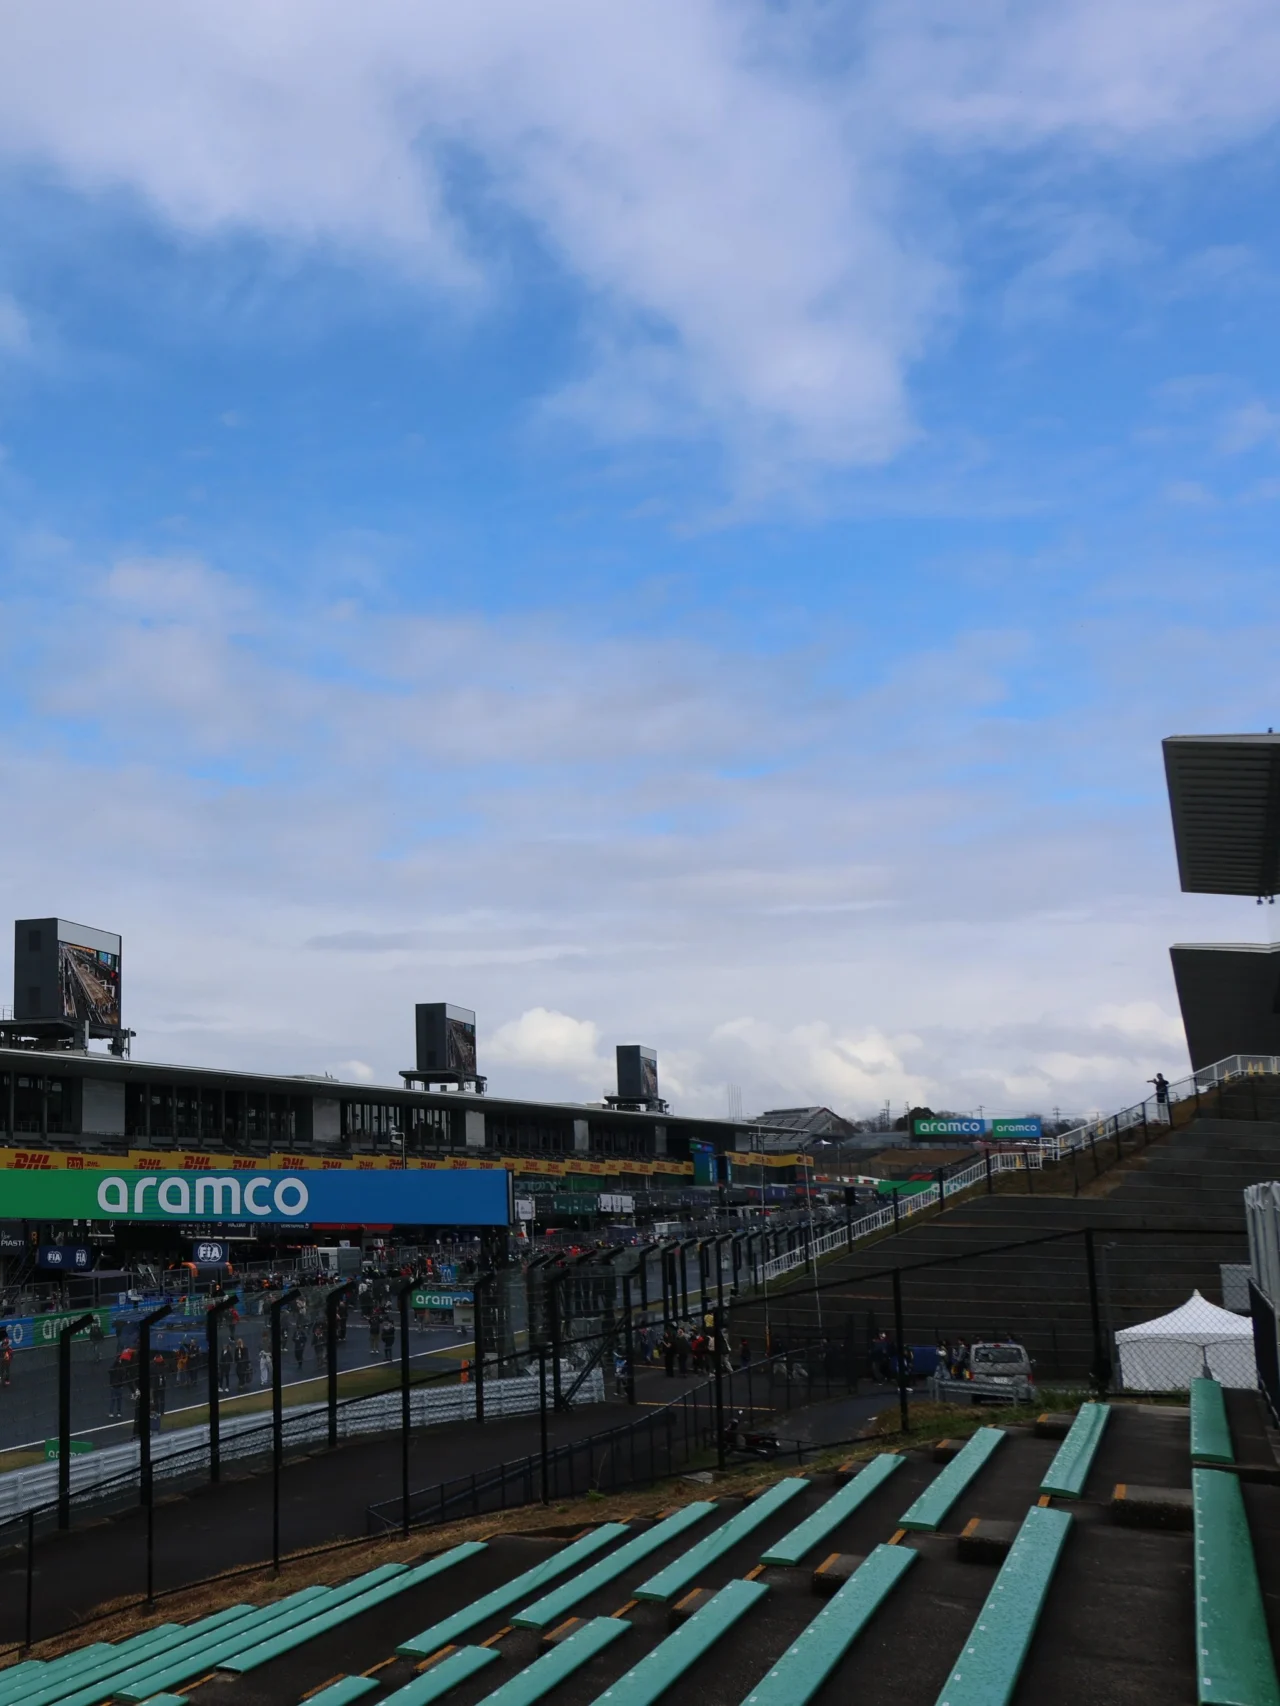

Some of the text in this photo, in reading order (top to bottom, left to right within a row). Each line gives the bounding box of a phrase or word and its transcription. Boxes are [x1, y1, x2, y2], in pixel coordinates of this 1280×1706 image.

[919, 1120, 981, 1133] aramco
[995, 1123, 1038, 1133] aramco
[14, 1153, 52, 1170] DHL
[138, 1158, 164, 1170] DHL
[183, 1155, 212, 1170] DHL
[97, 1176, 309, 1216] aramco
[200, 1246, 221, 1258] FIA
